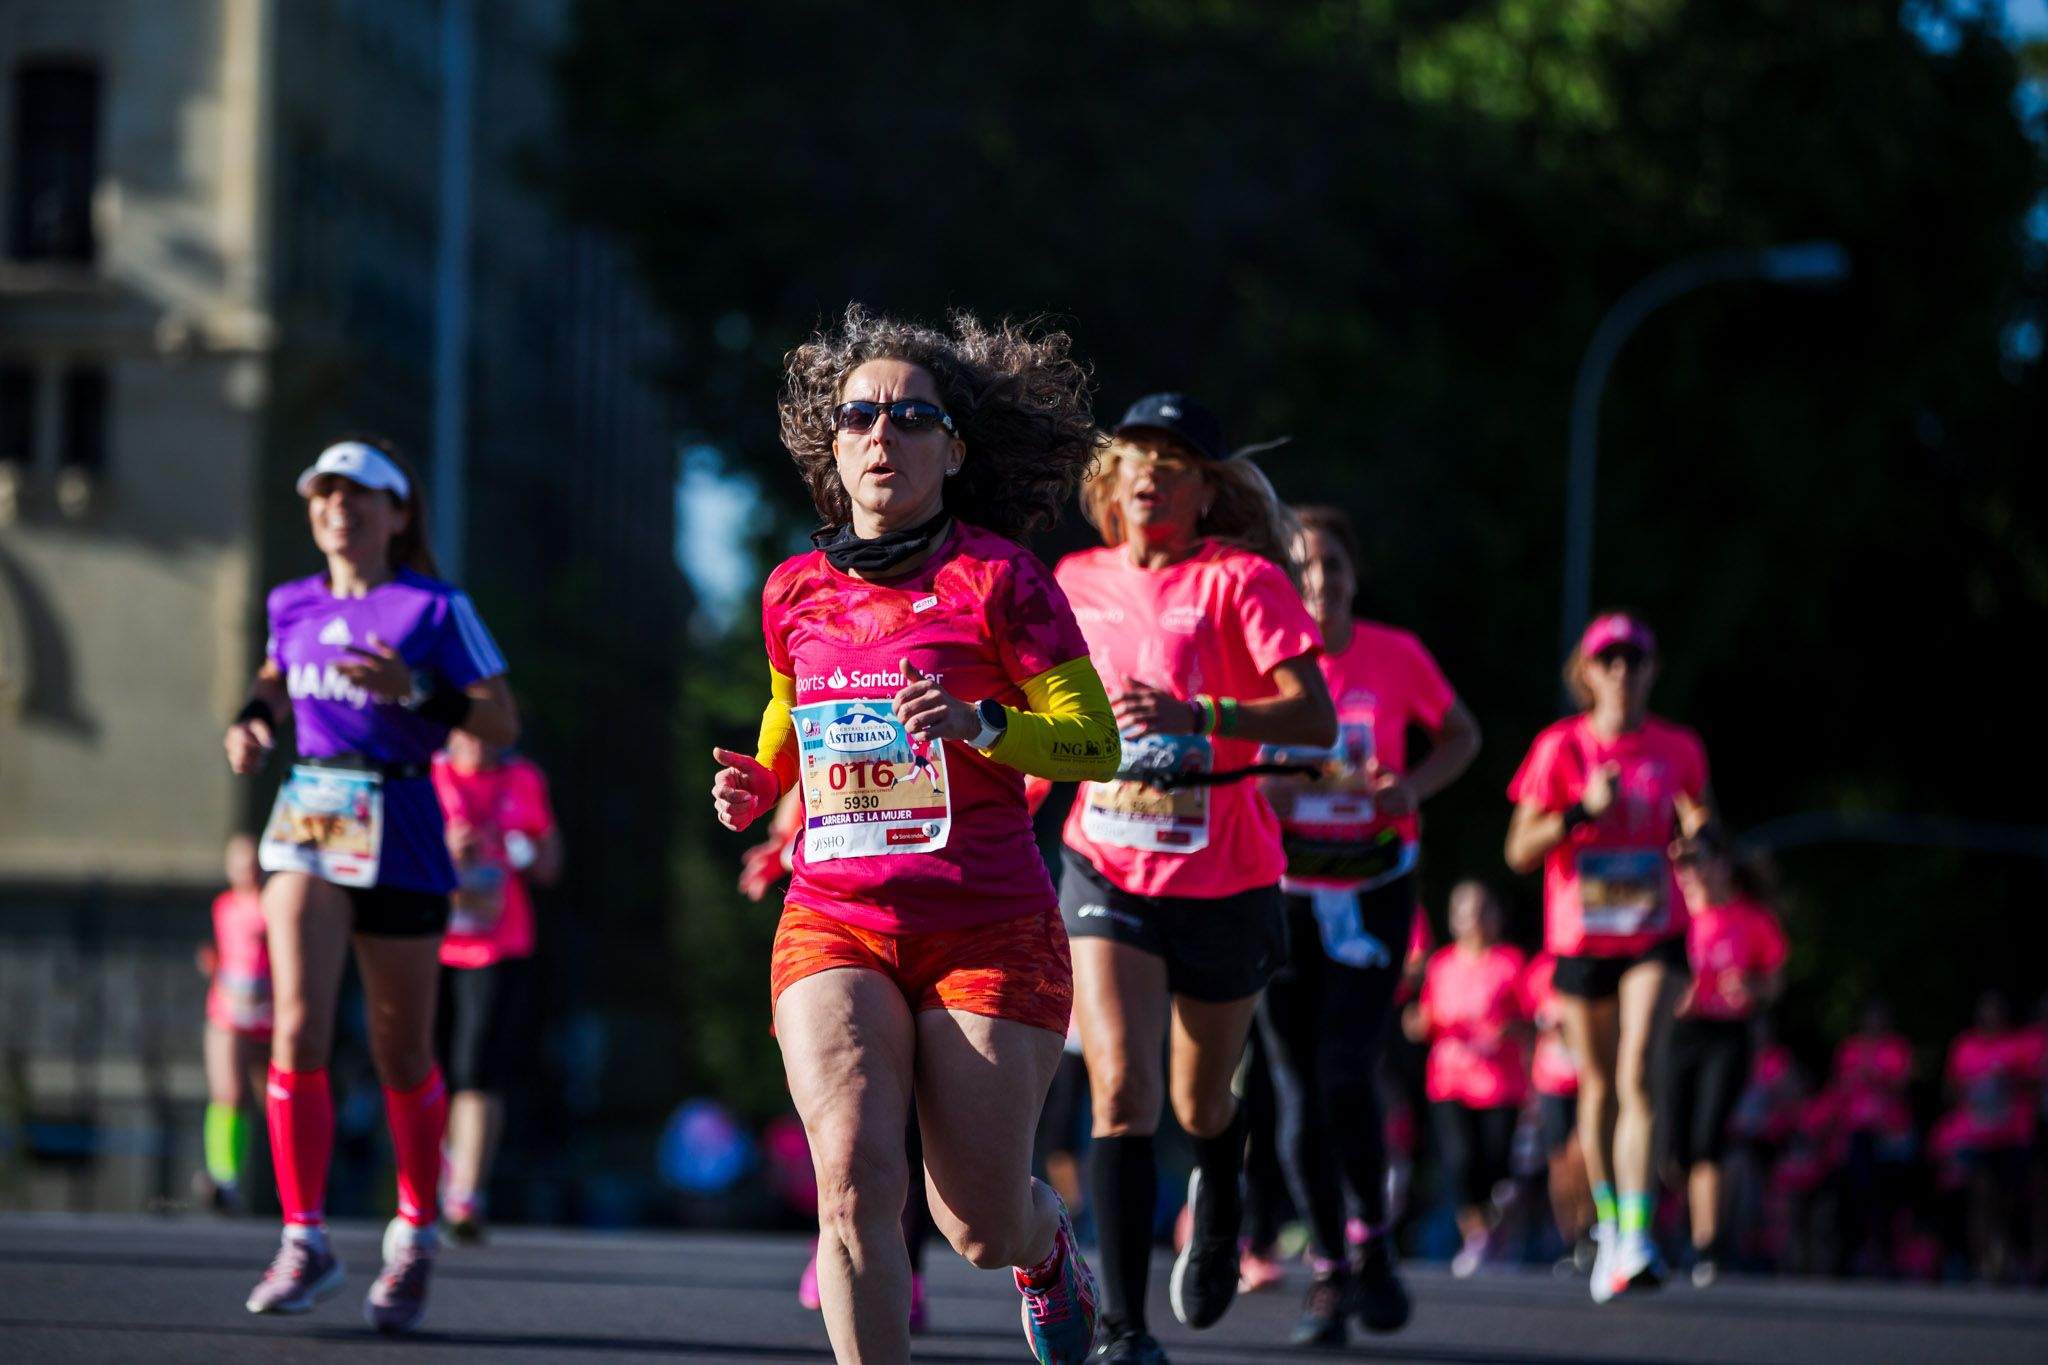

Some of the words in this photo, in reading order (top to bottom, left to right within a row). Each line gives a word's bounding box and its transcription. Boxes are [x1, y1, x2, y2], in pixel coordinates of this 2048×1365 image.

[797, 674, 825, 692] ports
[850, 669, 944, 688] Santaner
[828, 730, 893, 744] ASTURIANA
[1053, 741, 1082, 755] ING
[829, 760, 894, 790] 016
[844, 795, 879, 809] 5930
[821, 813, 851, 826] CARRERA
[853, 812, 865, 823] DE
[867, 811, 879, 821] LA
[881, 809, 912, 821] MUJER
